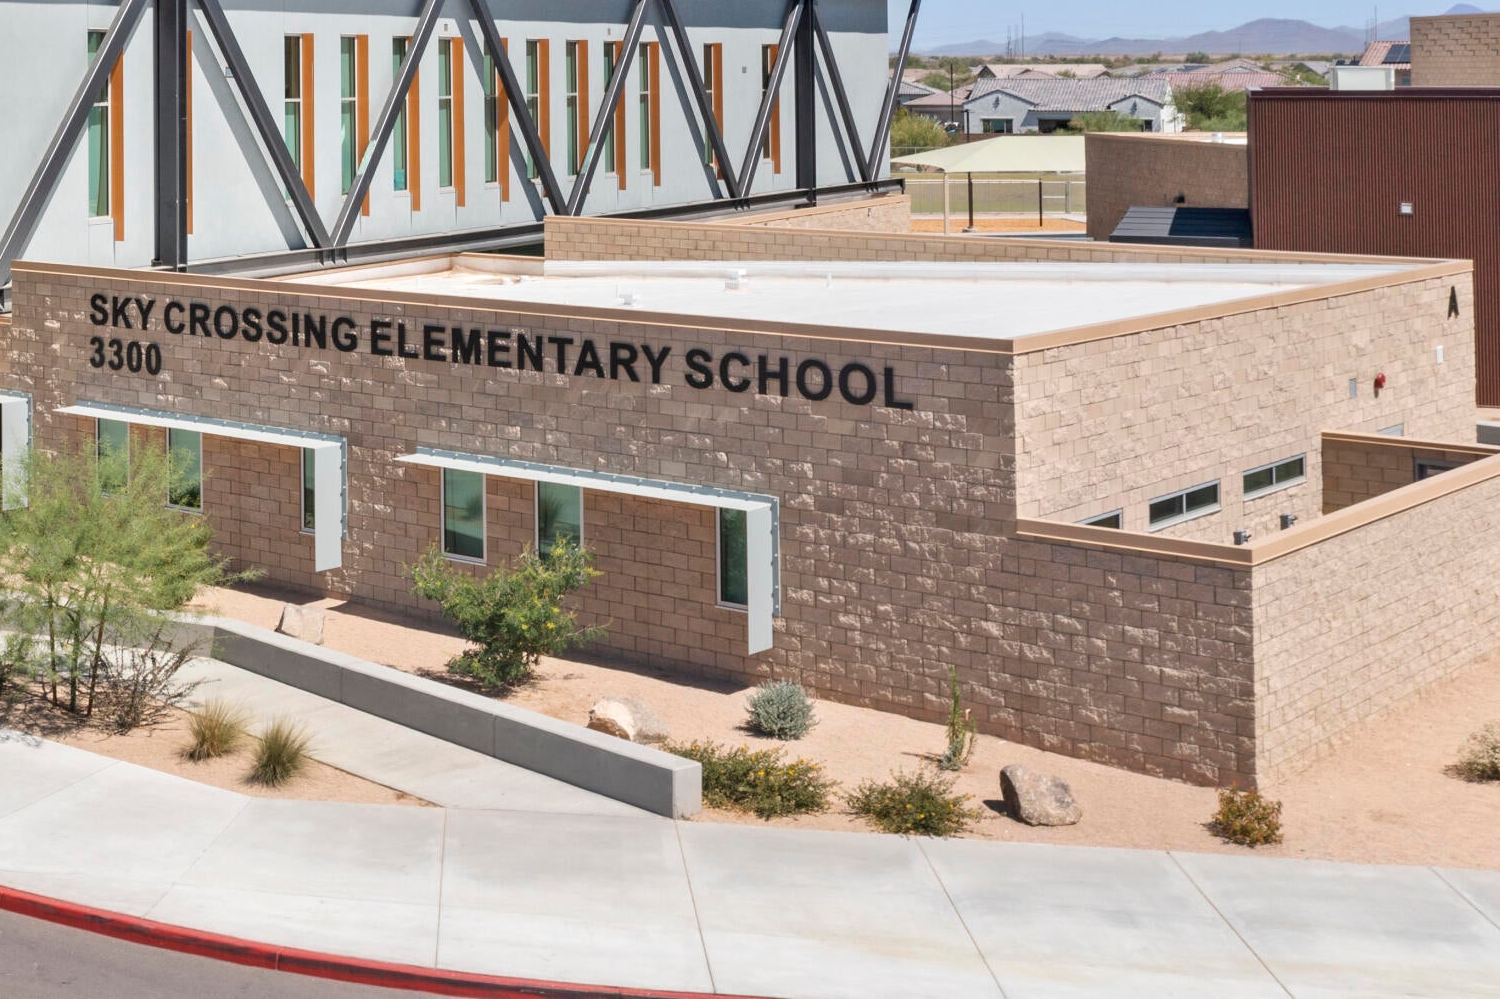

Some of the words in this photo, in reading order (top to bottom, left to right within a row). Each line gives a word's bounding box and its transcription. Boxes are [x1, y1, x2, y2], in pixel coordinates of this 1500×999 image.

[88, 336, 163, 377] 3300
[89, 293, 156, 332] SKY
[163, 300, 359, 353] CROSSING
[370, 320, 672, 386] ELEMENTARY
[684, 348, 915, 412] SCHOOL
